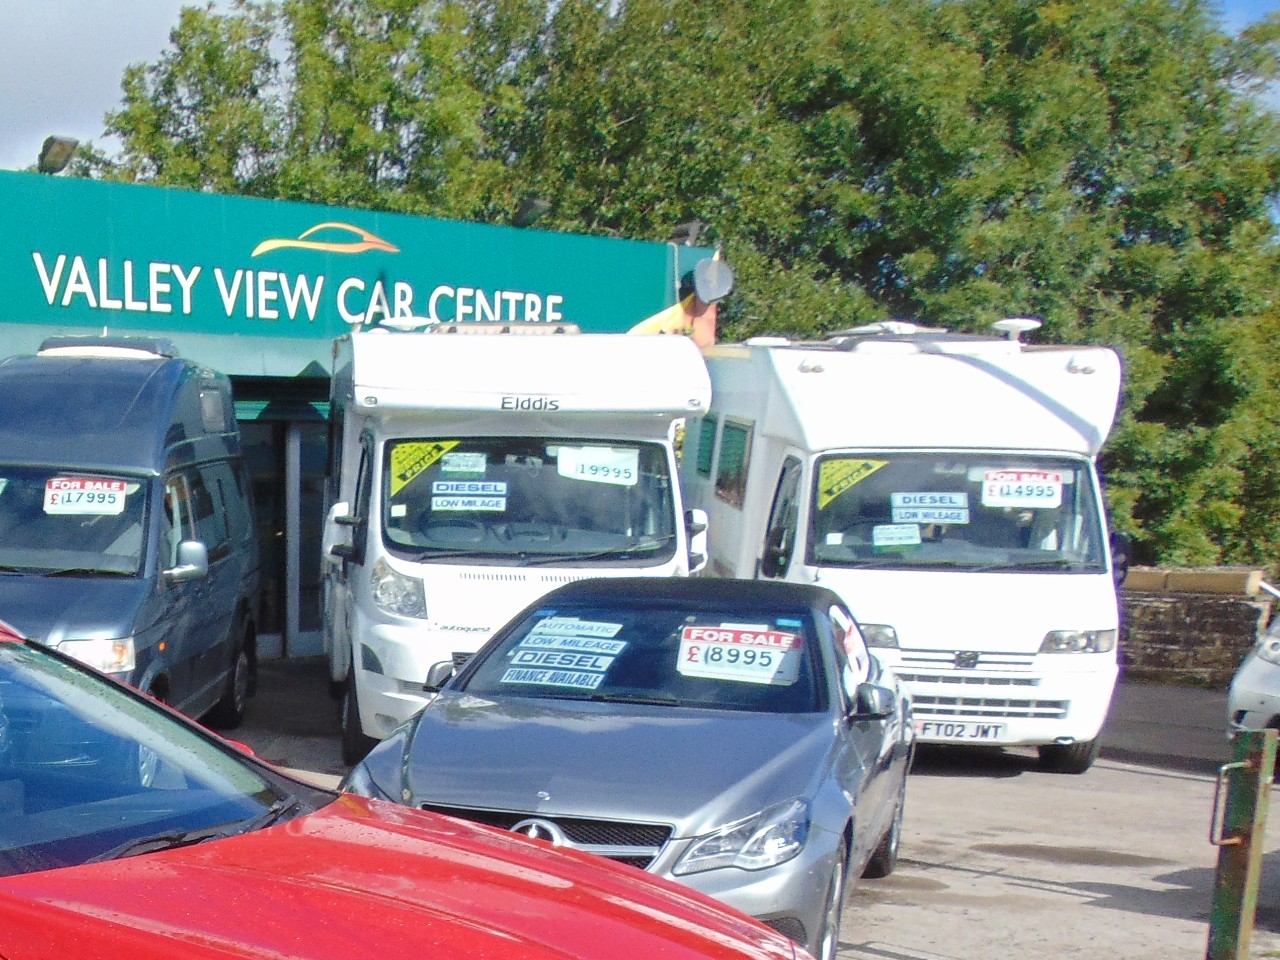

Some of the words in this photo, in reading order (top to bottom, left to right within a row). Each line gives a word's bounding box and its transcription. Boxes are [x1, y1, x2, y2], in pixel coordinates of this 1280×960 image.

[32, 251, 201, 314] VALLEY
[214, 267, 324, 323] VIEW
[337, 277, 413, 324] CAR
[429, 285, 563, 323] CENTRE
[501, 396, 559, 410] Elddis
[580, 464, 632, 479] 19995
[51, 481, 81, 490] FOR
[84, 481, 120, 490] SALE
[436, 483, 504, 492] DIESEL
[435, 500, 459, 508] LOW
[902, 495, 957, 504] DIESEL
[899, 511, 917, 519] LOW
[921, 511, 962, 520] MILEAGE
[440, 624, 491, 633] autoquest
[539, 622, 613, 634] AUTOMATIC
[524, 636, 556, 646] LOW
[561, 638, 621, 651] MILEAGE
[690, 629, 734, 642] FOR
[740, 633, 795, 647] SALE
[519, 651, 603, 669] DIESEL
[506, 669, 547, 682] FINANCE
[548, 671, 600, 687] AVAILABLE
[923, 722, 965, 737] FT02
[969, 725, 1002, 738] JWT
